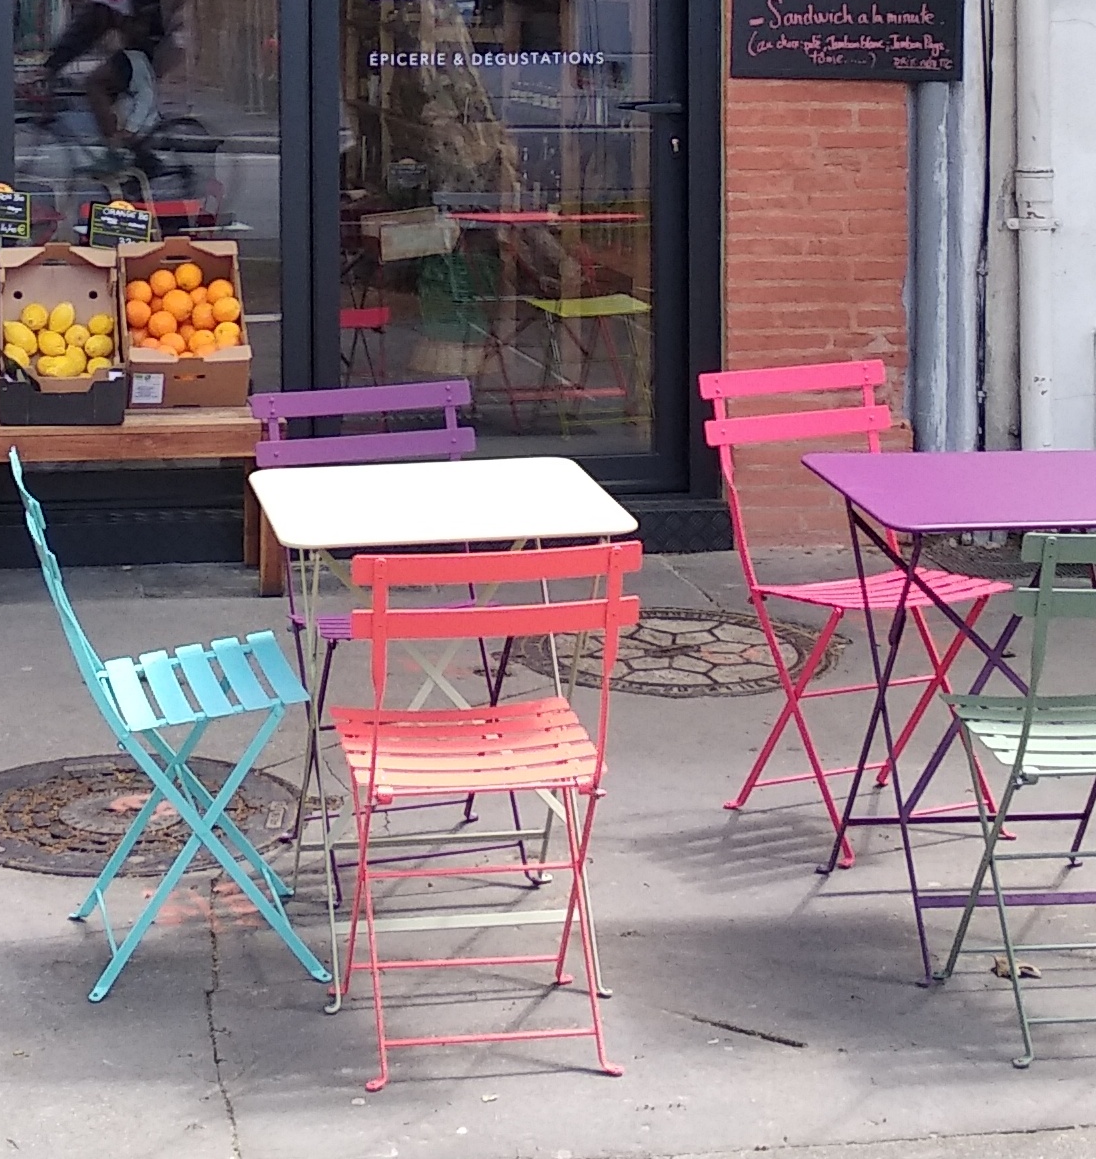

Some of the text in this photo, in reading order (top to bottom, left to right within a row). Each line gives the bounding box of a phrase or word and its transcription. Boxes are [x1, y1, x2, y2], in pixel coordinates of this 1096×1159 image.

[368, 50, 606, 67] ÉPICERIE & DÉGUSTATIONS
